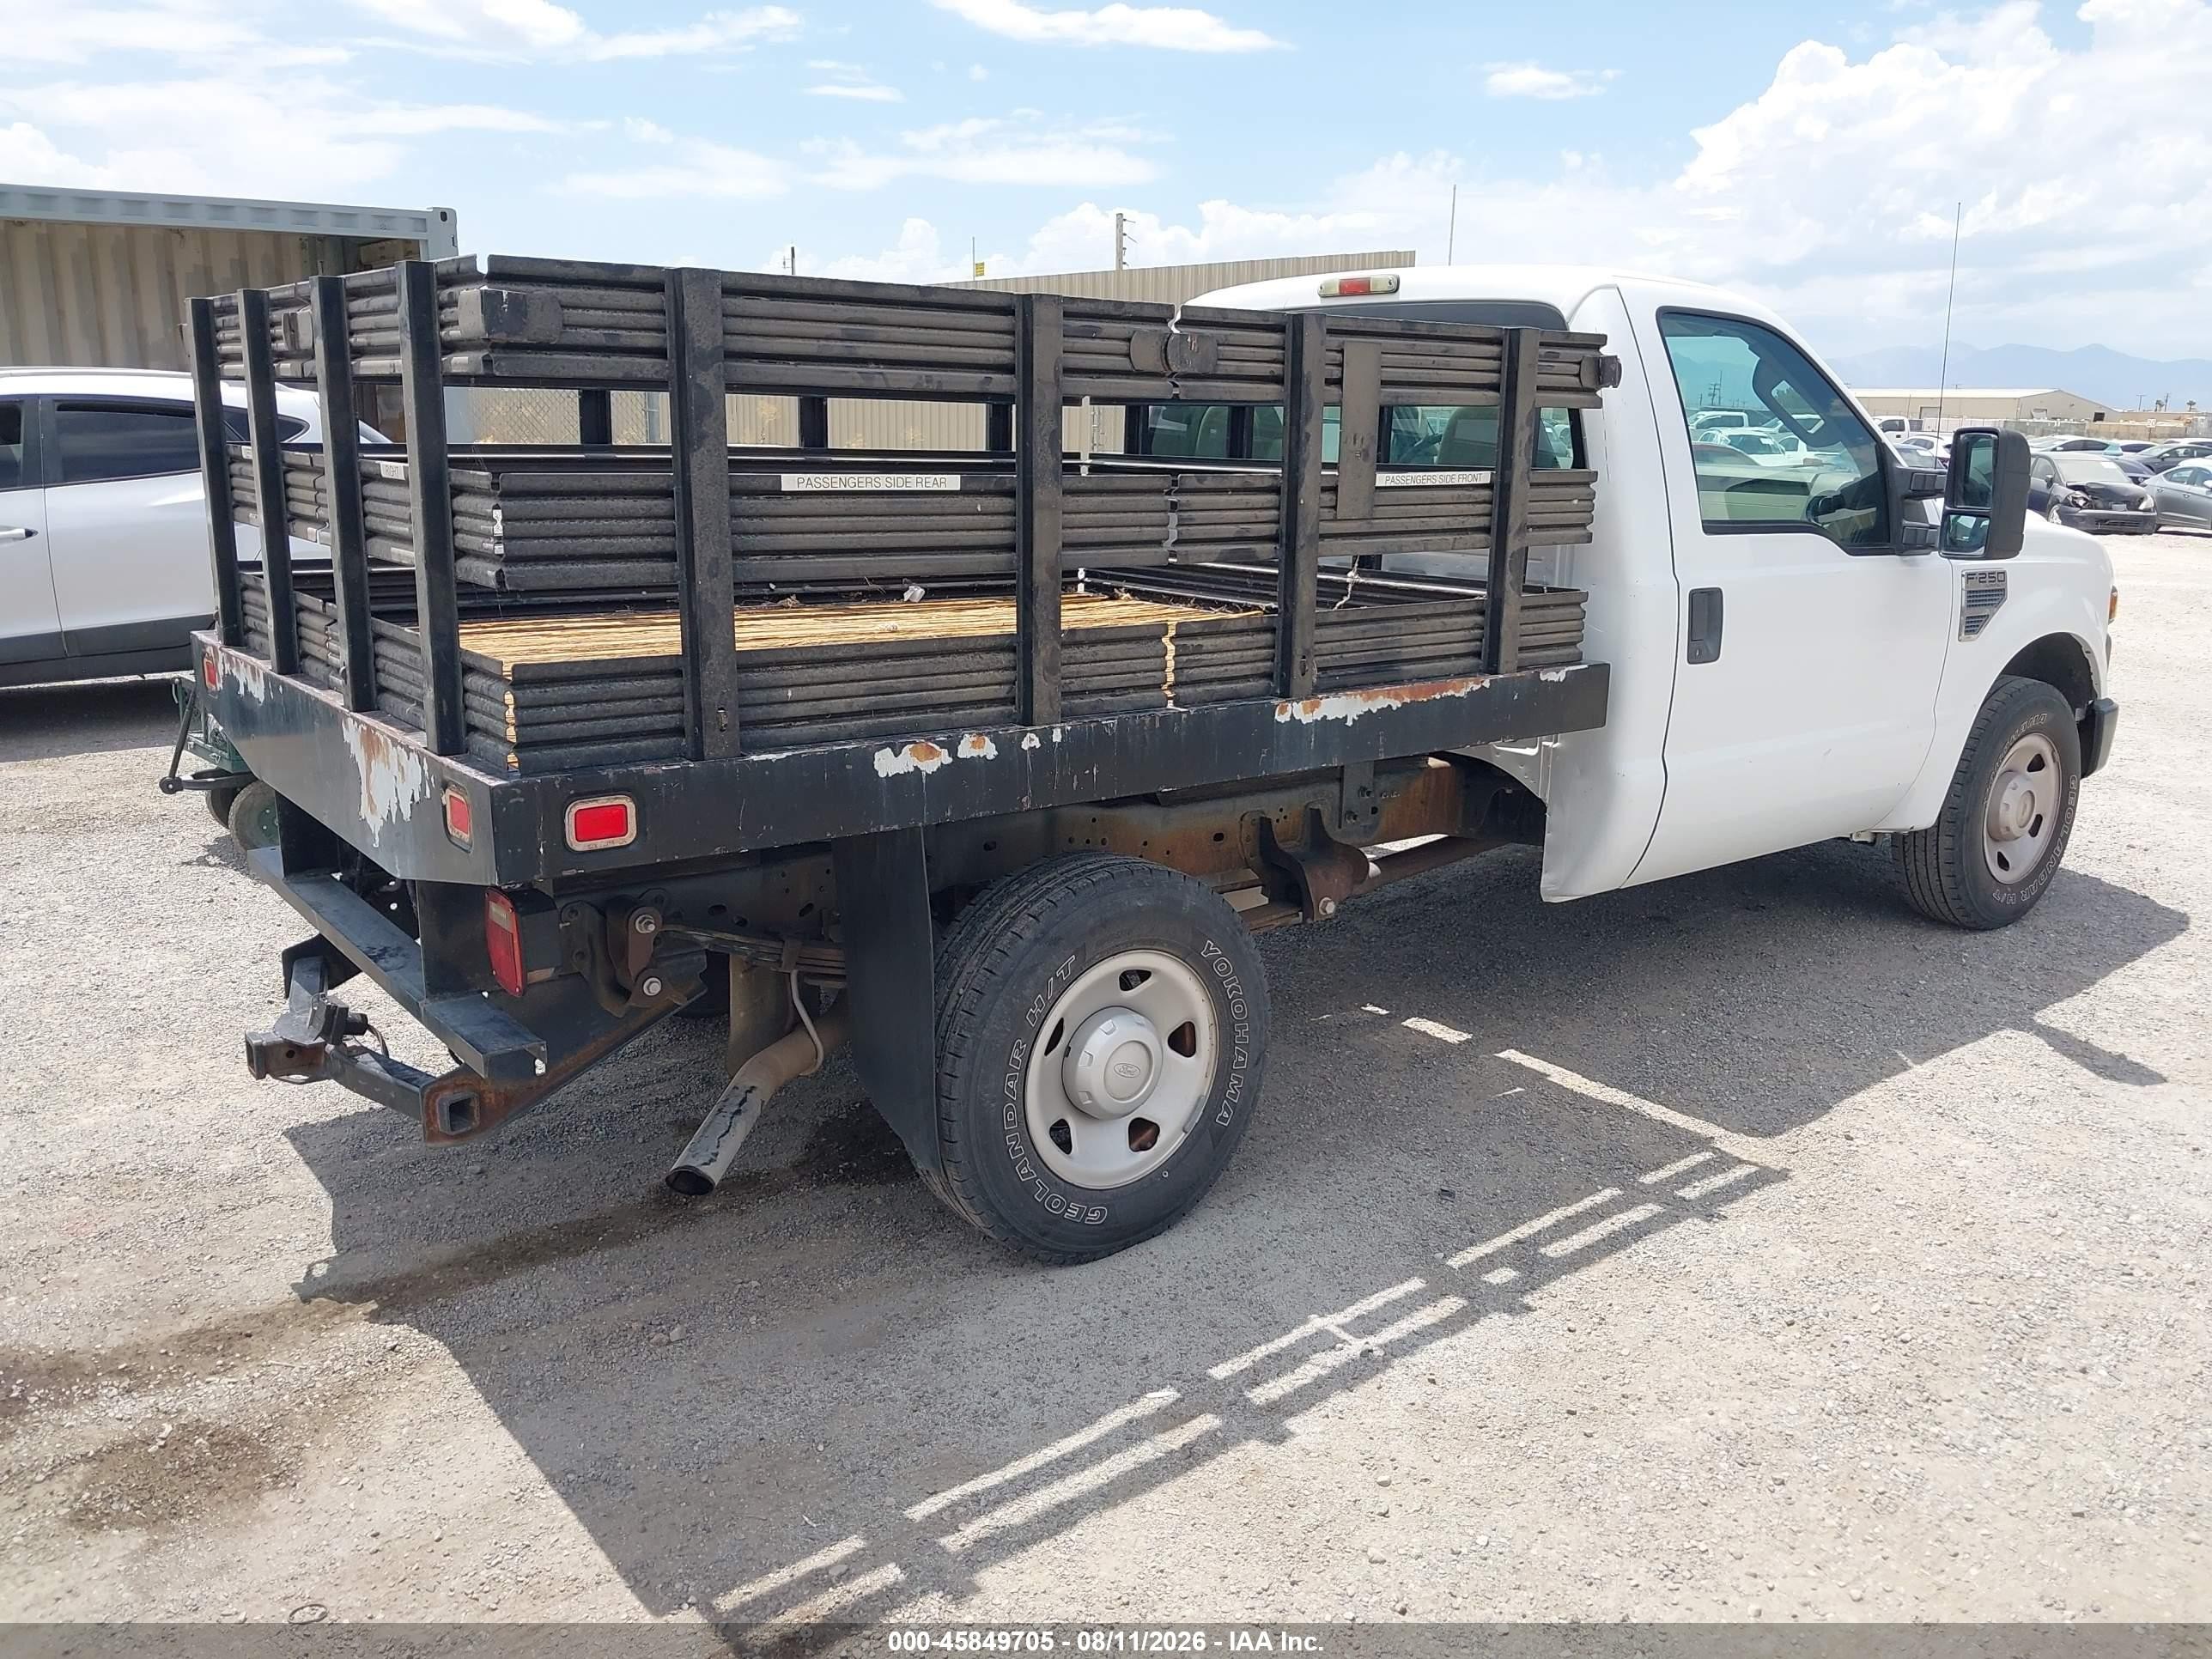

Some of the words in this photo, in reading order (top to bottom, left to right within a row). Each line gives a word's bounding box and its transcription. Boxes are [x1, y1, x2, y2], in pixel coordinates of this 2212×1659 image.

[797, 477, 881, 489] PASSENGERS
[885, 477, 910, 488] SIDE
[915, 477, 947, 488] REAR
[1385, 475, 1437, 485] PASSENGERS
[1438, 474, 1455, 483] SIDE
[1457, 473, 1482, 483] FRONT
[2021, 774, 2078, 902] GEOLANDAR
[1991, 886, 2017, 905] H/T
[1025, 954, 1076, 1028] H/T
[1200, 939, 1249, 1127] YOKOHAMA
[1002, 1037, 1109, 1225] GEOLANDAR
